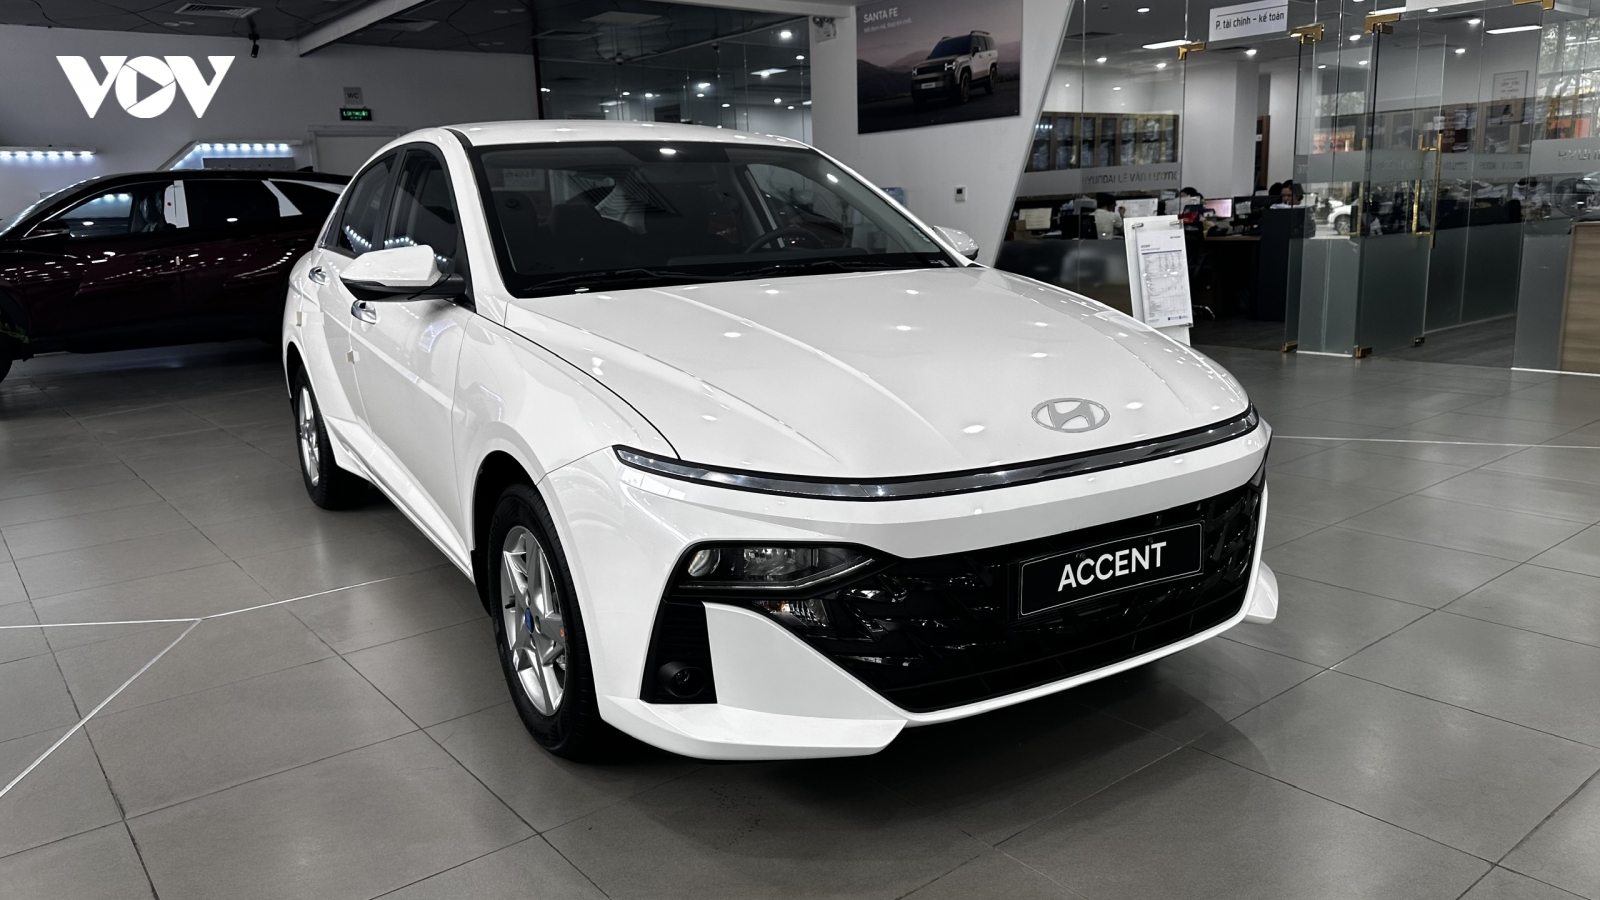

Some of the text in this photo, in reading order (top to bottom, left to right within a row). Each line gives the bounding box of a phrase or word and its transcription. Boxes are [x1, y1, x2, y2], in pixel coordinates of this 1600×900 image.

[863, 7, 899, 23] SANTA FE
[1223, 19, 1231, 29] tài
[1233, 16, 1251, 28] chính
[1259, 12, 1267, 23] kế
[1269, 11, 1285, 22] toán
[1082, 174, 1116, 185] HYUNDAI
[1057, 541, 1167, 592] ACCENT
